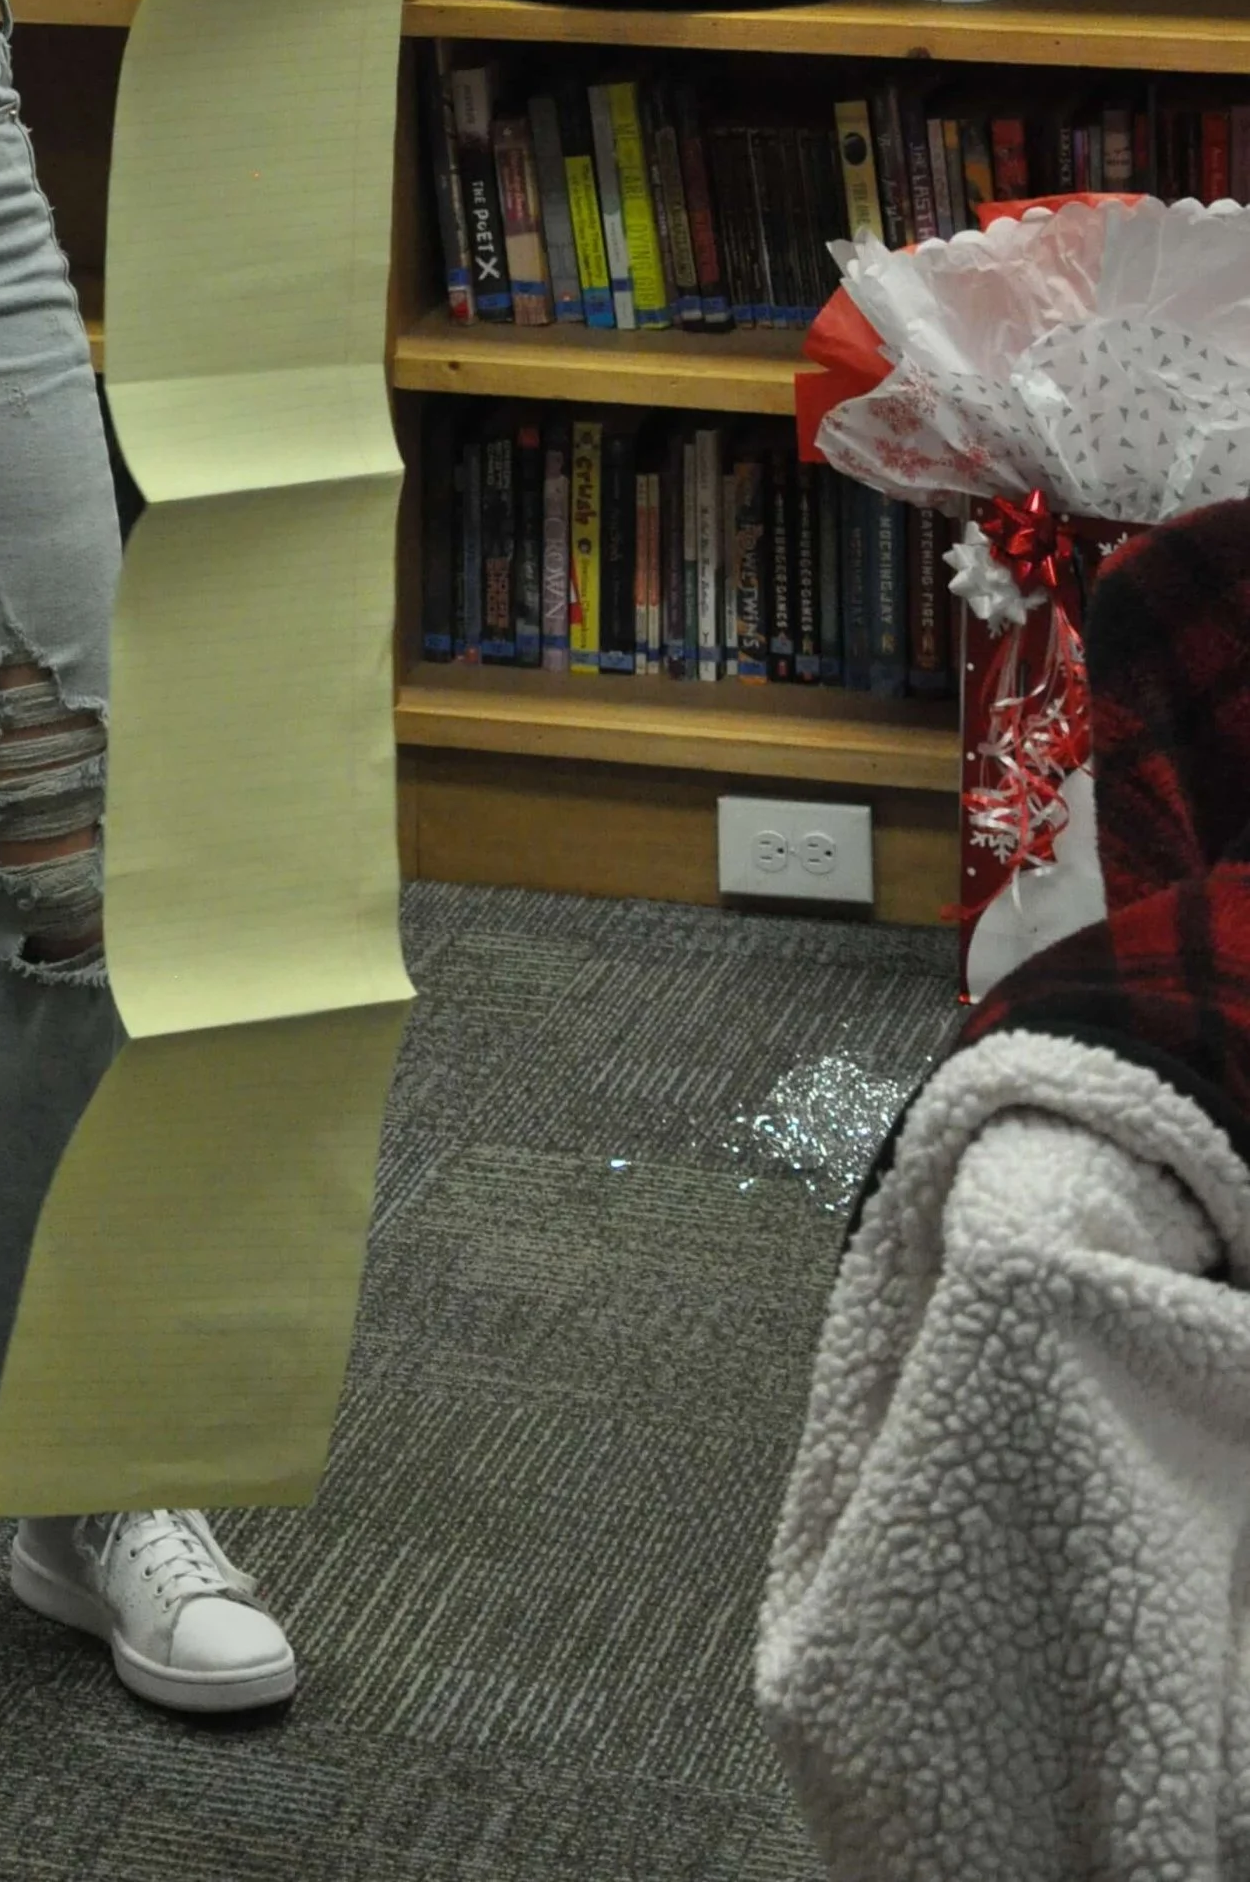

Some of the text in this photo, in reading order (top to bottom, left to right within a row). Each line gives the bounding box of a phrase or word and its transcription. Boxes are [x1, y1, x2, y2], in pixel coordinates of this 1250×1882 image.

[471, 181, 500, 281] THE POET X
[624, 223, 651, 271] DYING
[911, 174, 929, 222] LAST
[542, 516, 567, 622] CROWN
[741, 581, 762, 650] TWINS
[773, 526, 790, 629] HUNGER GAMES
[799, 530, 814, 633] HUNGER GAMES
[878, 516, 894, 625] MOCKINGJAY
[919, 509, 935, 630] CATCHING FIRE
